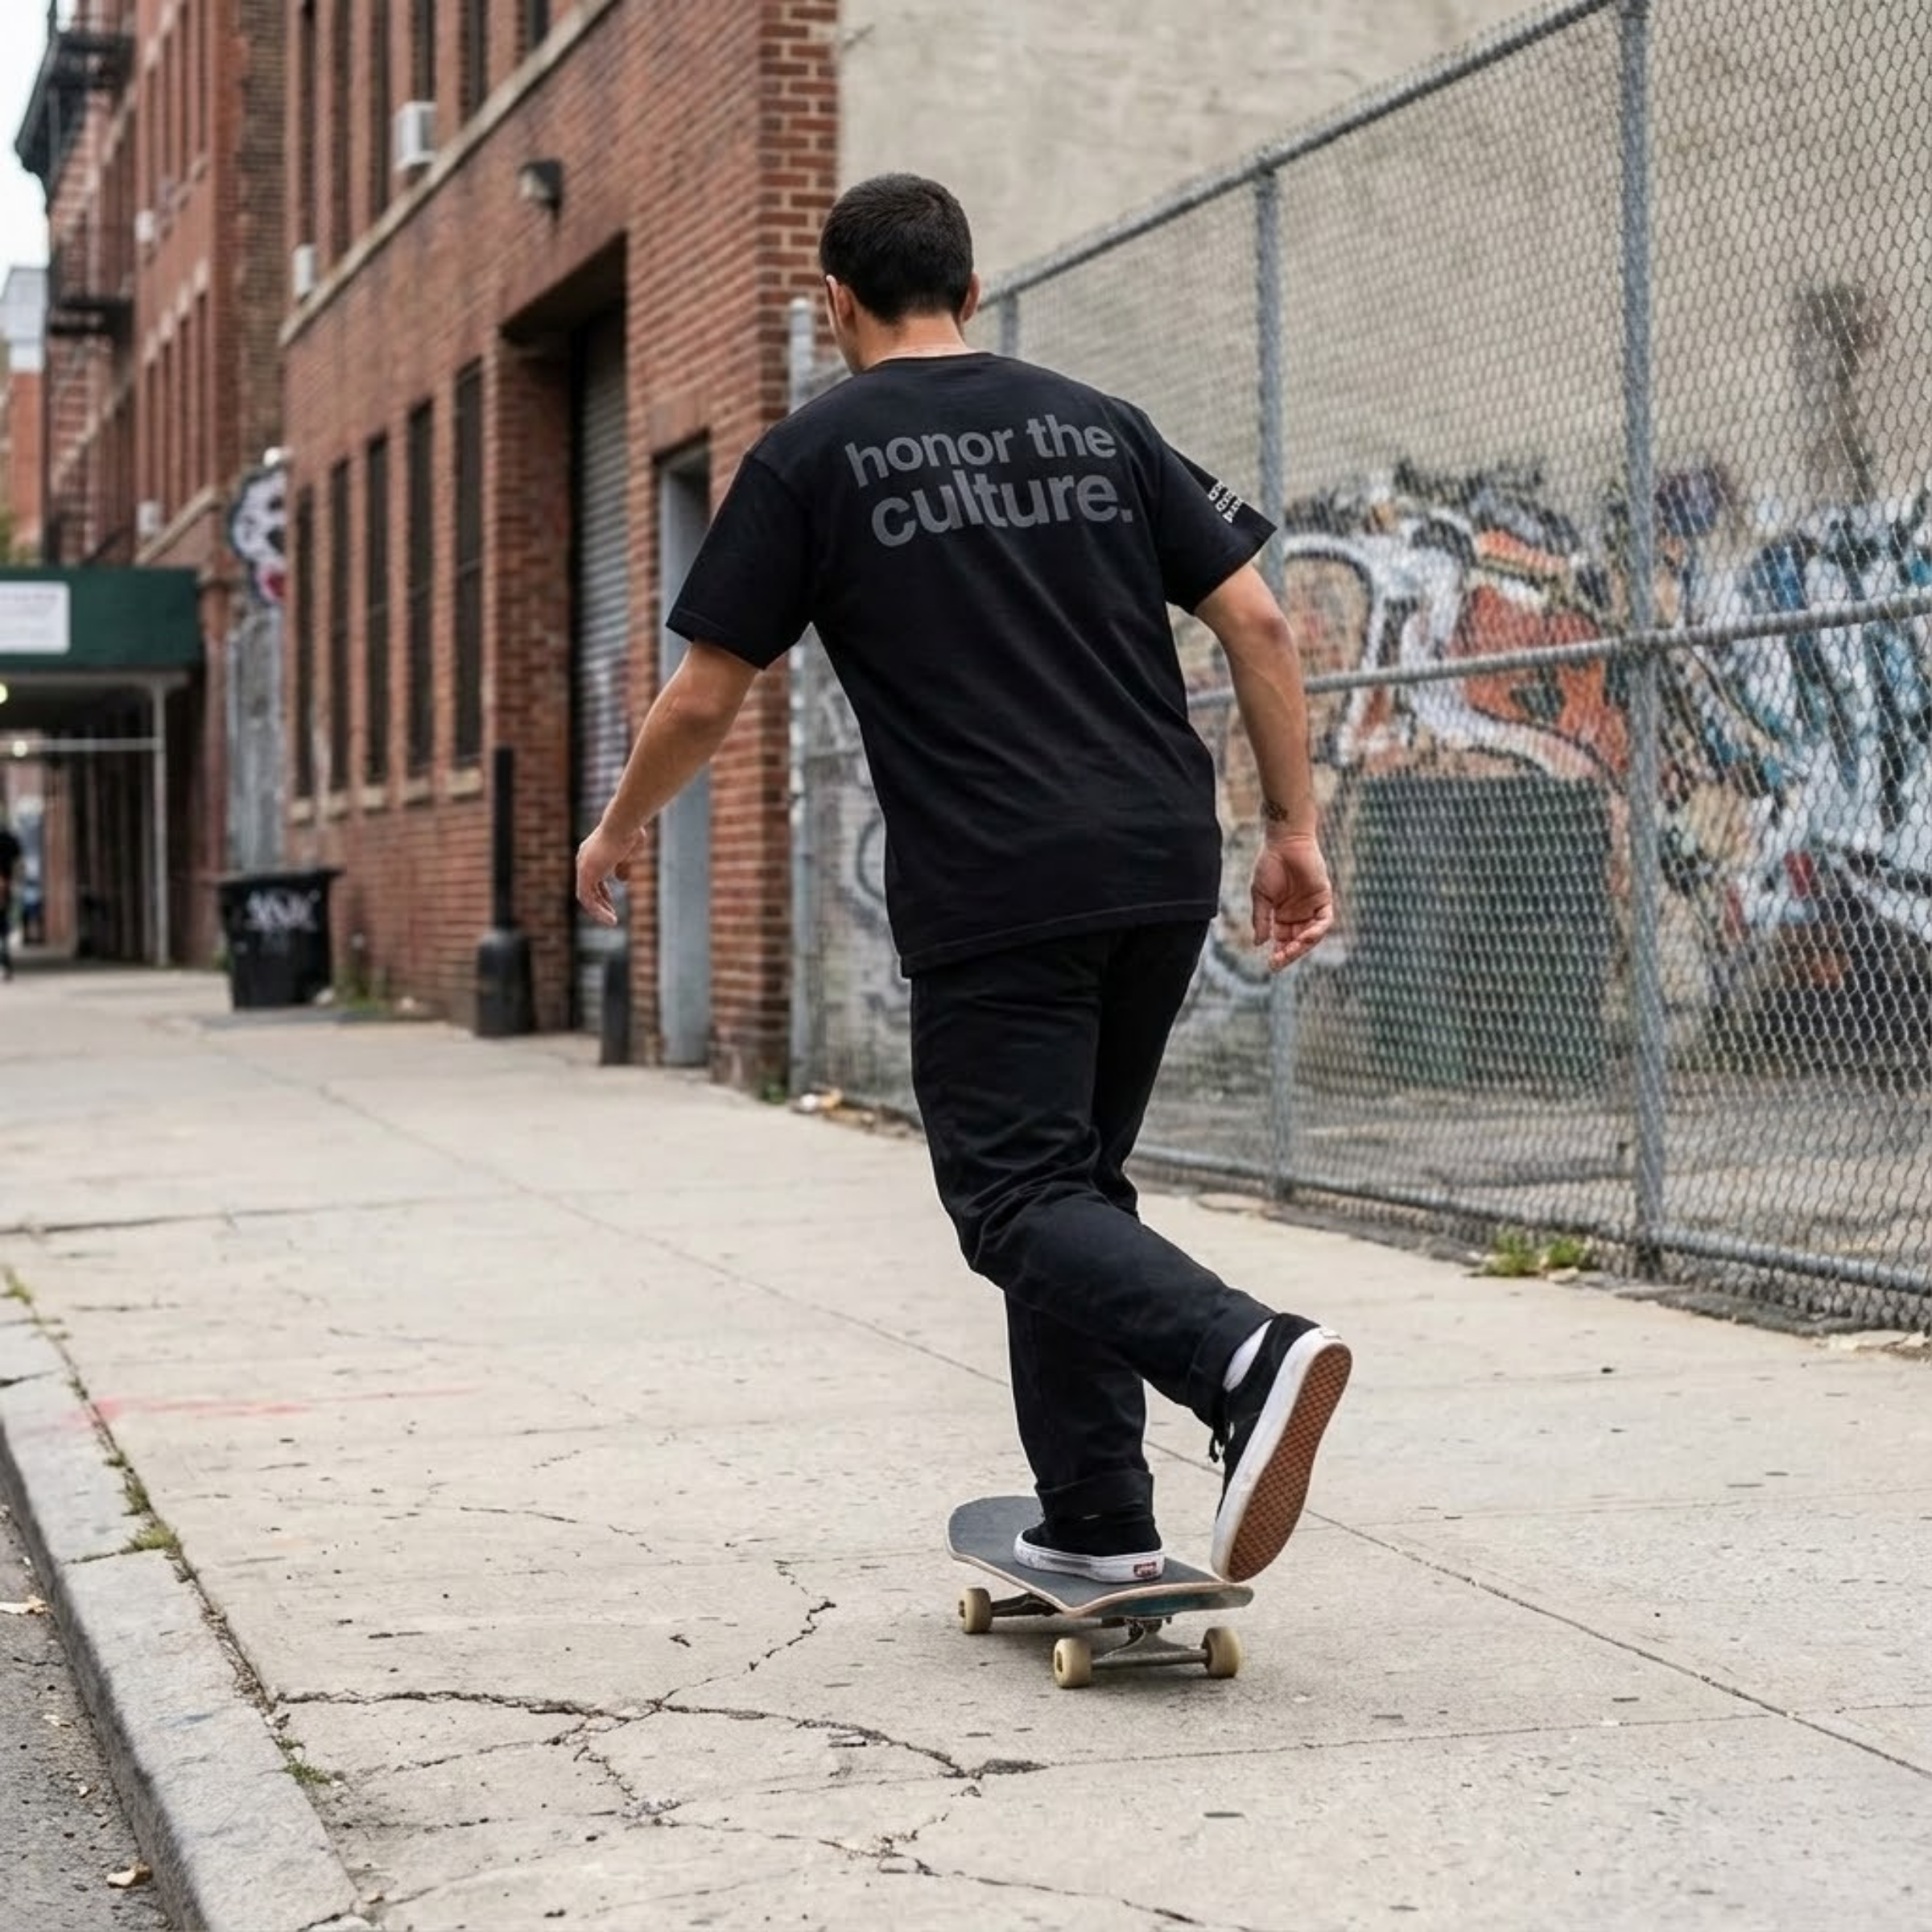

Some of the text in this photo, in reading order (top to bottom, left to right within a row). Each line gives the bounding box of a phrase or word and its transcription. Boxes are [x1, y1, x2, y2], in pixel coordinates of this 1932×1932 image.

[844, 413, 1117, 487] honor the
[872, 469, 1133, 547] culture.
